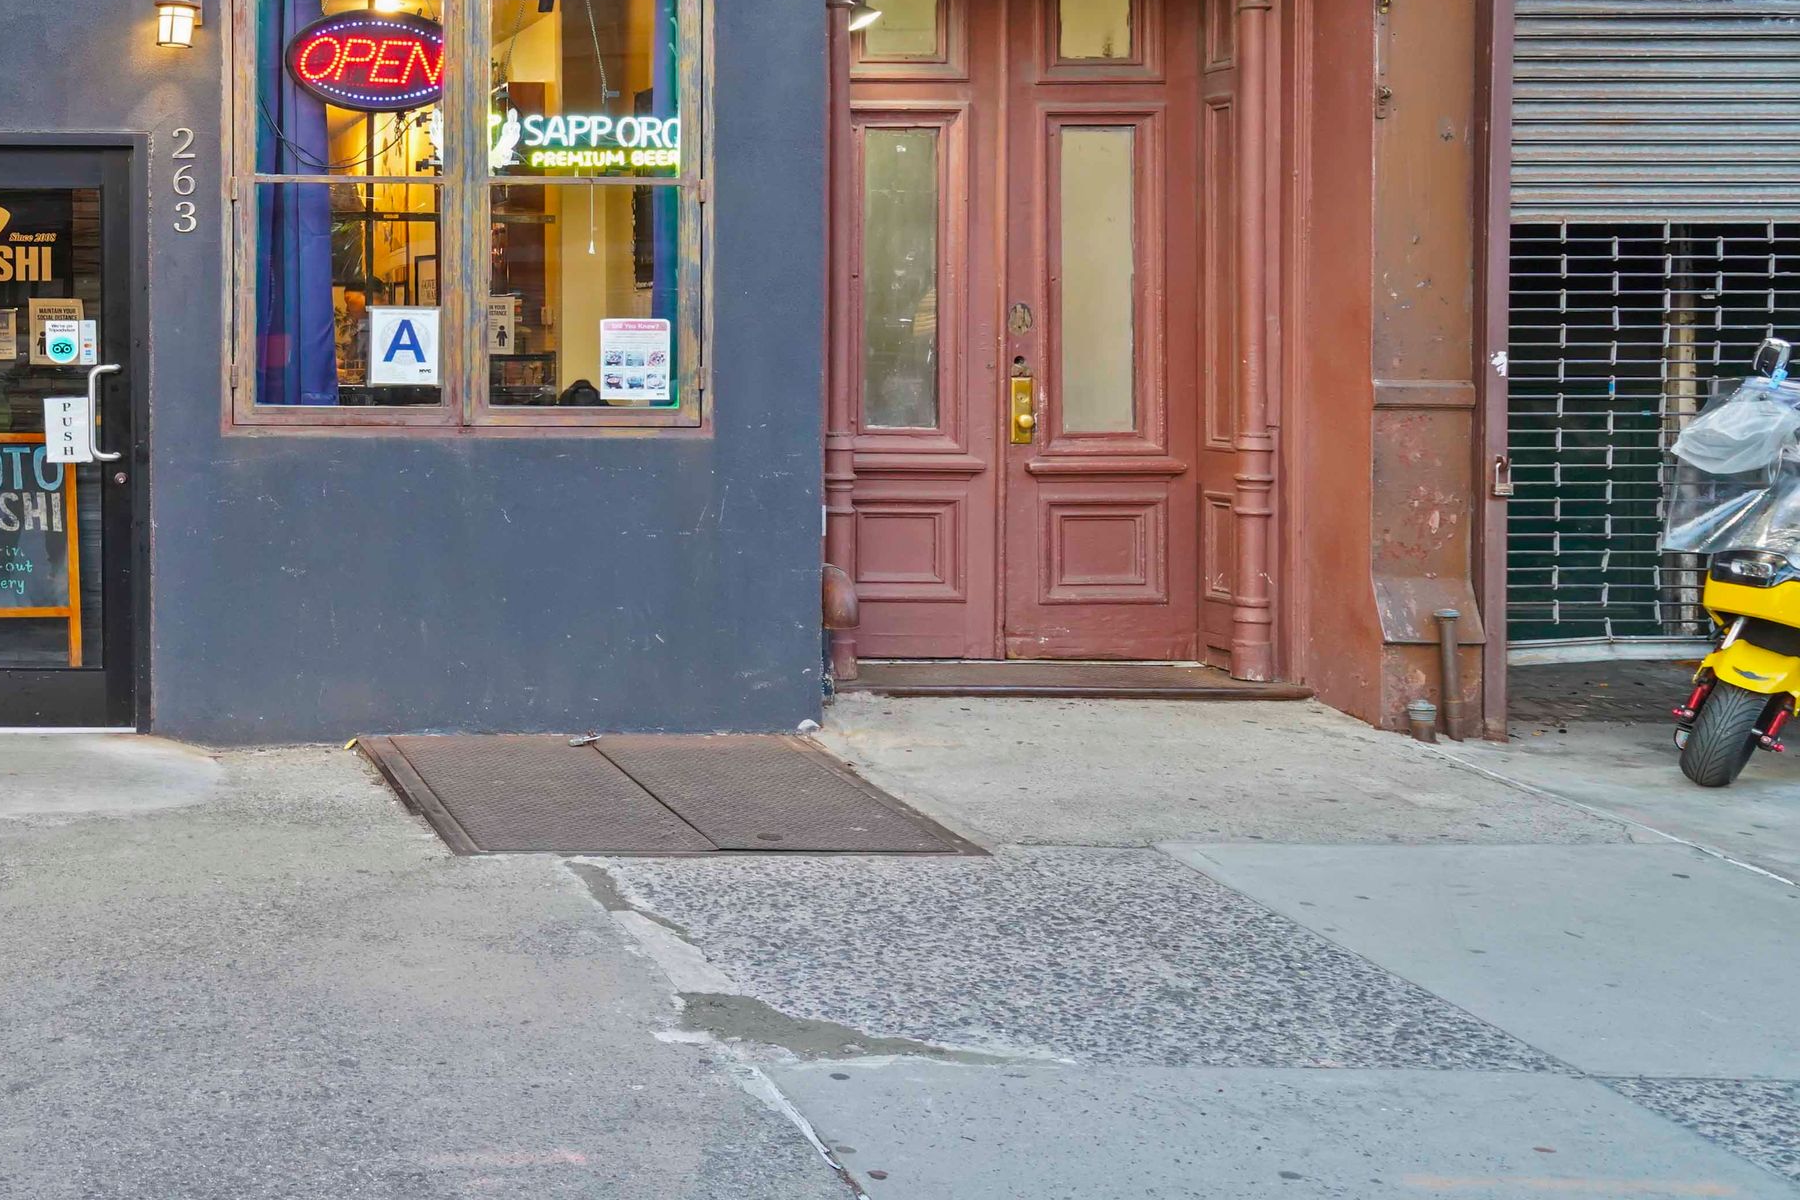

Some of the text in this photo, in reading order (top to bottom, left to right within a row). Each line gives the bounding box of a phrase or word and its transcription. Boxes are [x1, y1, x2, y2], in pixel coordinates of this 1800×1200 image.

[299, 35, 443, 85] OPEN
[171, 127, 198, 233] 263
[531, 150, 625, 167] PREMIUM
[8, 233, 33, 242] Since
[383, 319, 427, 362] A
[62, 402, 74, 456] PUSH
